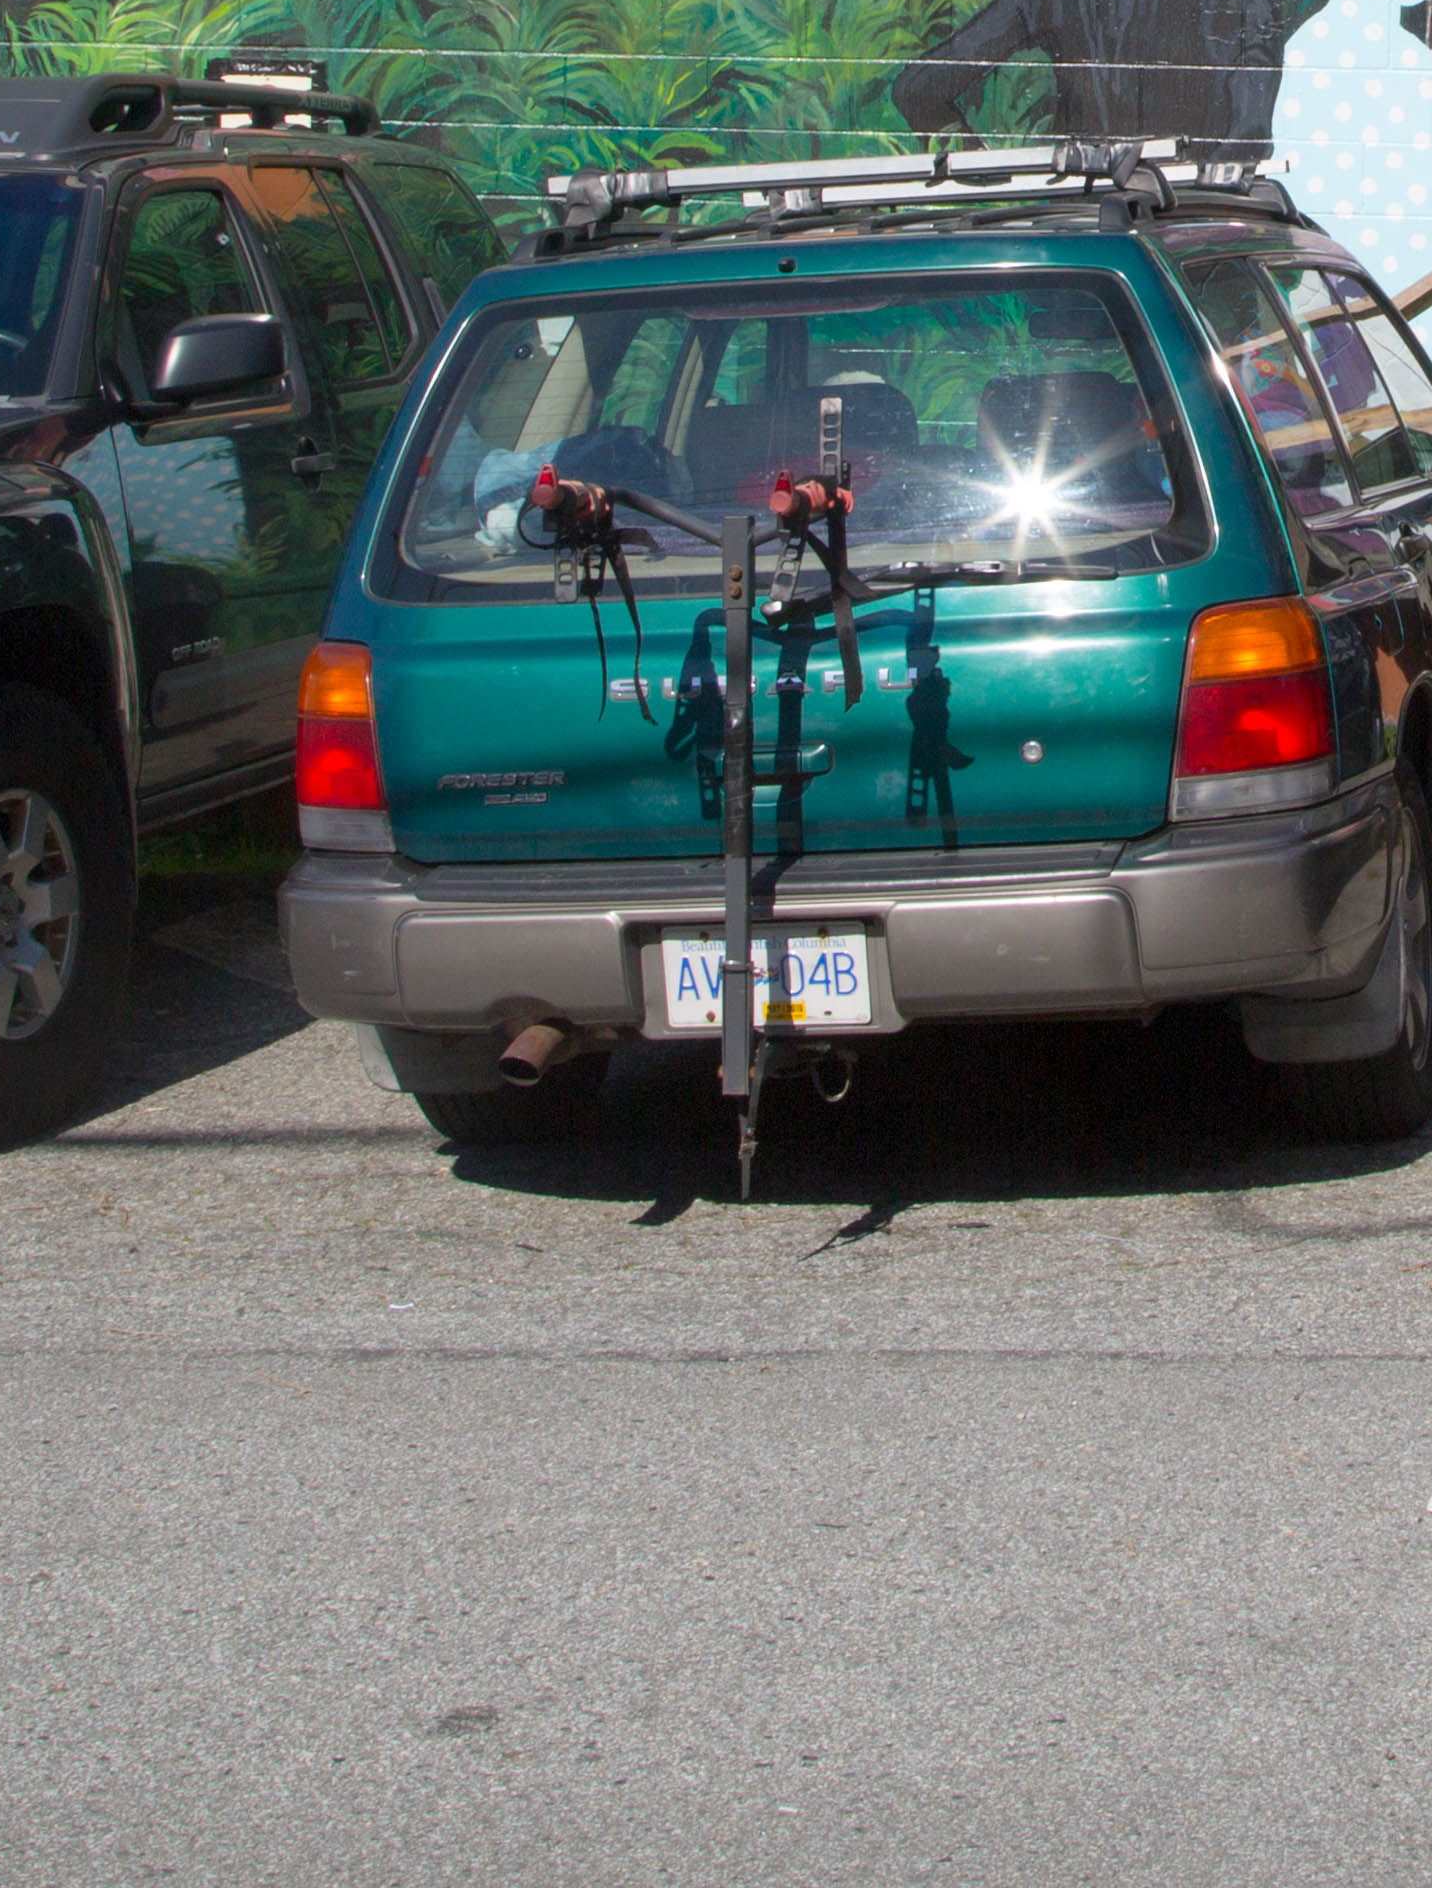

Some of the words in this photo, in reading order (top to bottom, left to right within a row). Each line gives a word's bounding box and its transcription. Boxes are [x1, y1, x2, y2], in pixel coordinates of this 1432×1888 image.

[437, 771, 565, 792] FORESTER
[678, 955, 726, 1001] AV
[780, 951, 858, 996] 04B
